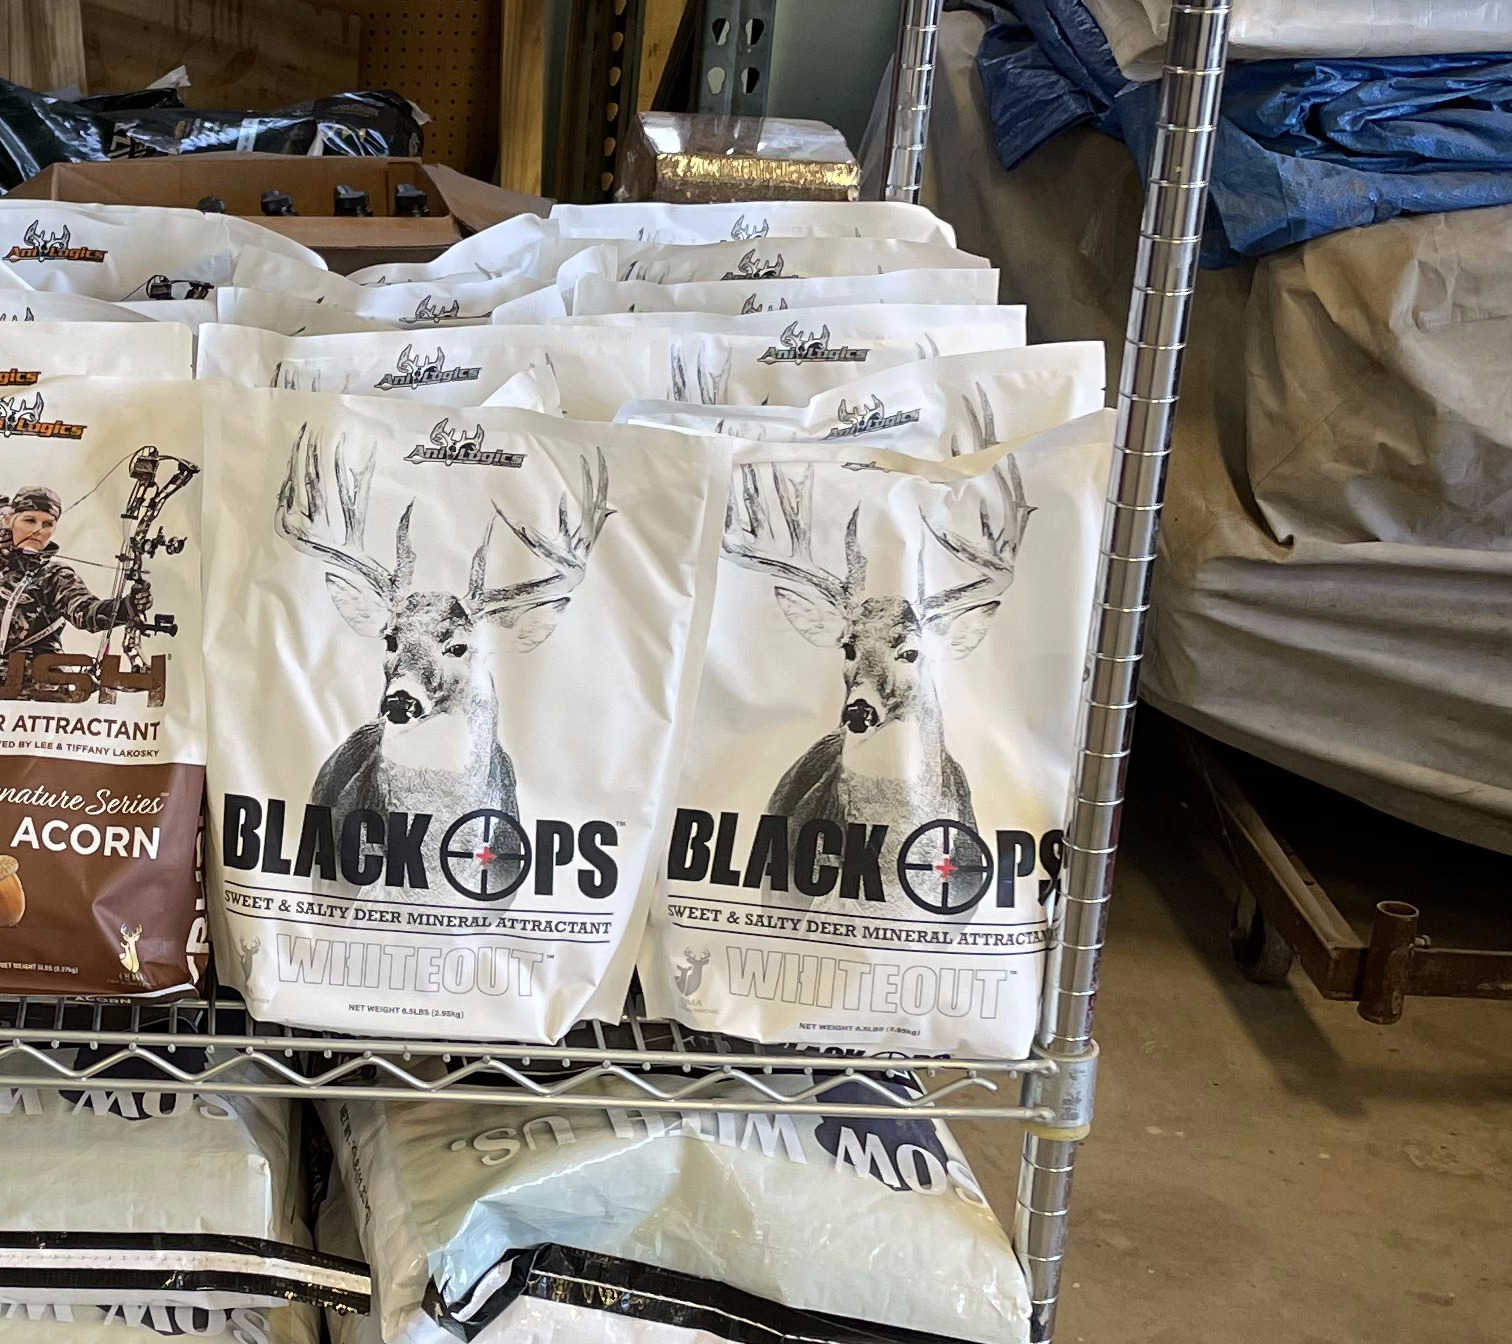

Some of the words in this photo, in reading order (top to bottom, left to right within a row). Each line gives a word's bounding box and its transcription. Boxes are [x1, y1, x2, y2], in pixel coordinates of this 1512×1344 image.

[11, 714, 161, 742] ATTRACTANT
[85, 788, 164, 817] Series
[10, 816, 161, 861] ACORN
[223, 793, 433, 891] BLACK
[667, 808, 889, 903] BLACK
[224, 888, 274, 913] SWEET
[277, 899, 292, 913] &
[295, 901, 349, 920] SALTY
[353, 906, 402, 925] DEER
[406, 911, 493, 929] MINERAL
[495, 917, 613, 935] ATTRACTANT
[668, 904, 723, 924] SWEET
[726, 910, 741, 924] &
[745, 911, 802, 933] SALTY
[805, 917, 857, 939] DEER
[862, 924, 954, 945] MINERAL
[277, 933, 545, 997] WHITEOUT
[726, 946, 1008, 1019] WHITEOUT
[349, 1003, 365, 1012] NET
[367, 1004, 400, 1015] WEIGHT
